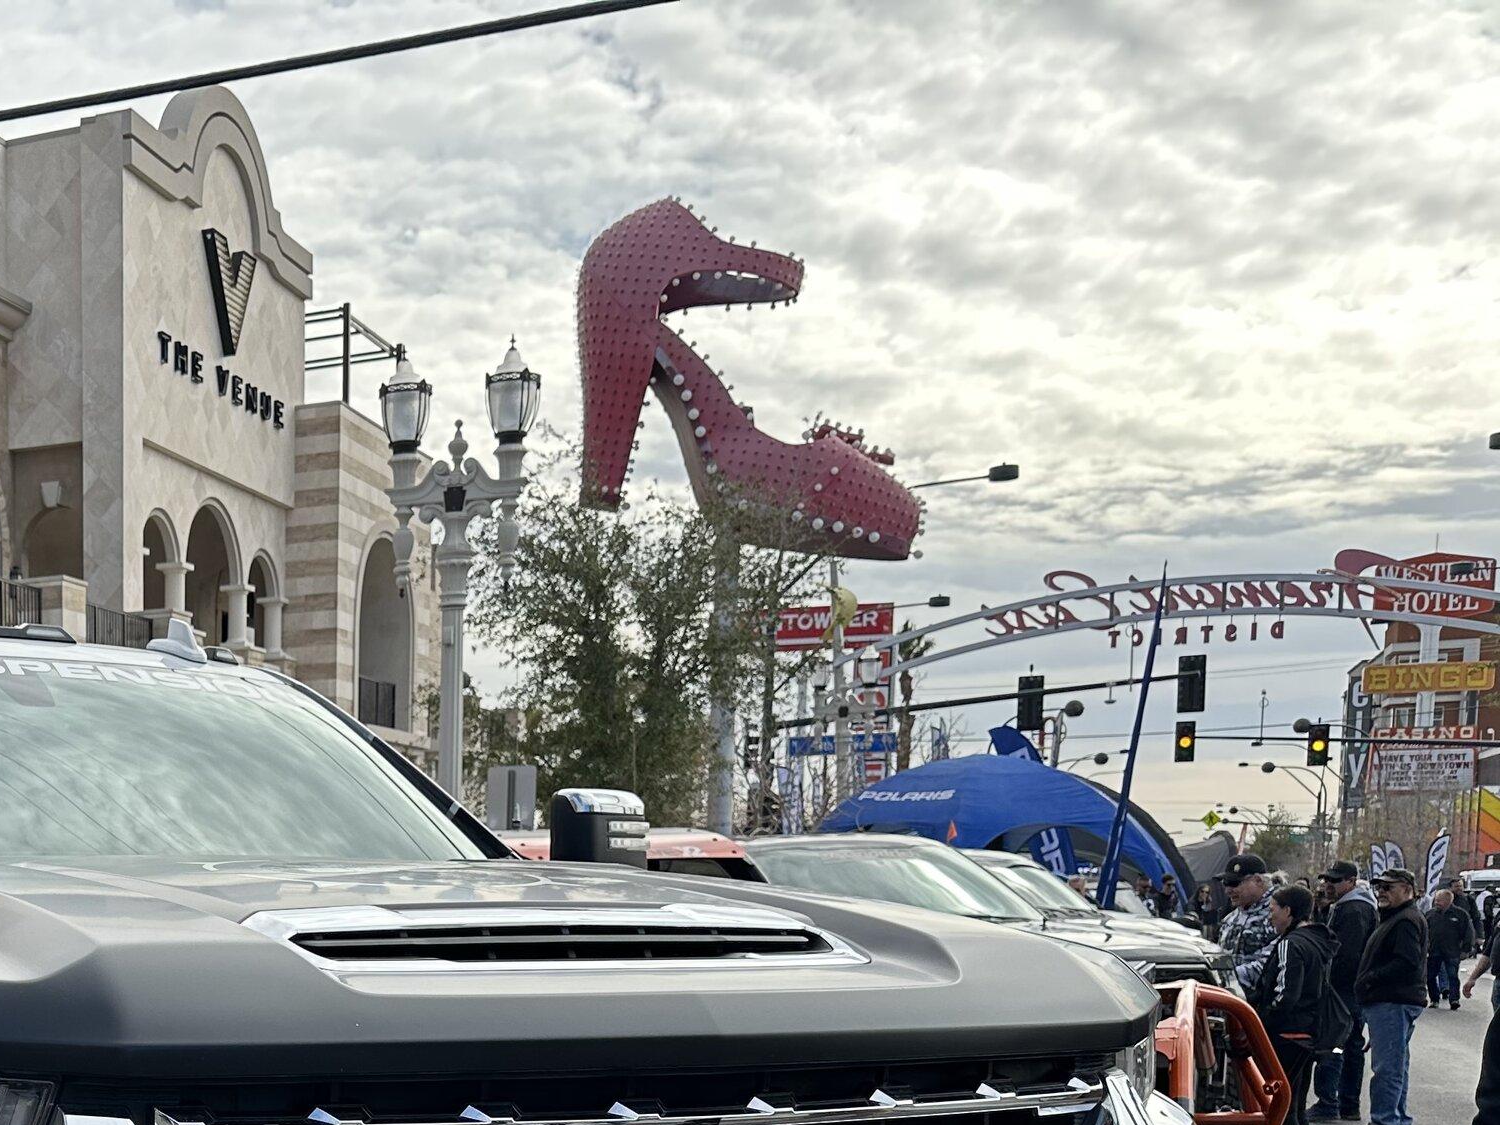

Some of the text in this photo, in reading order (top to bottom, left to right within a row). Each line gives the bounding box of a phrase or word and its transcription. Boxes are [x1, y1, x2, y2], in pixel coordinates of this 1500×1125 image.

[158, 331, 285, 430] THE VENUE
[1393, 591, 1480, 613] HOTEL
[1368, 665, 1488, 690] BINGO
[1377, 726, 1474, 739] CASINO
[1437, 752, 1467, 761] EVENT
[857, 789, 956, 801] POLARIS
